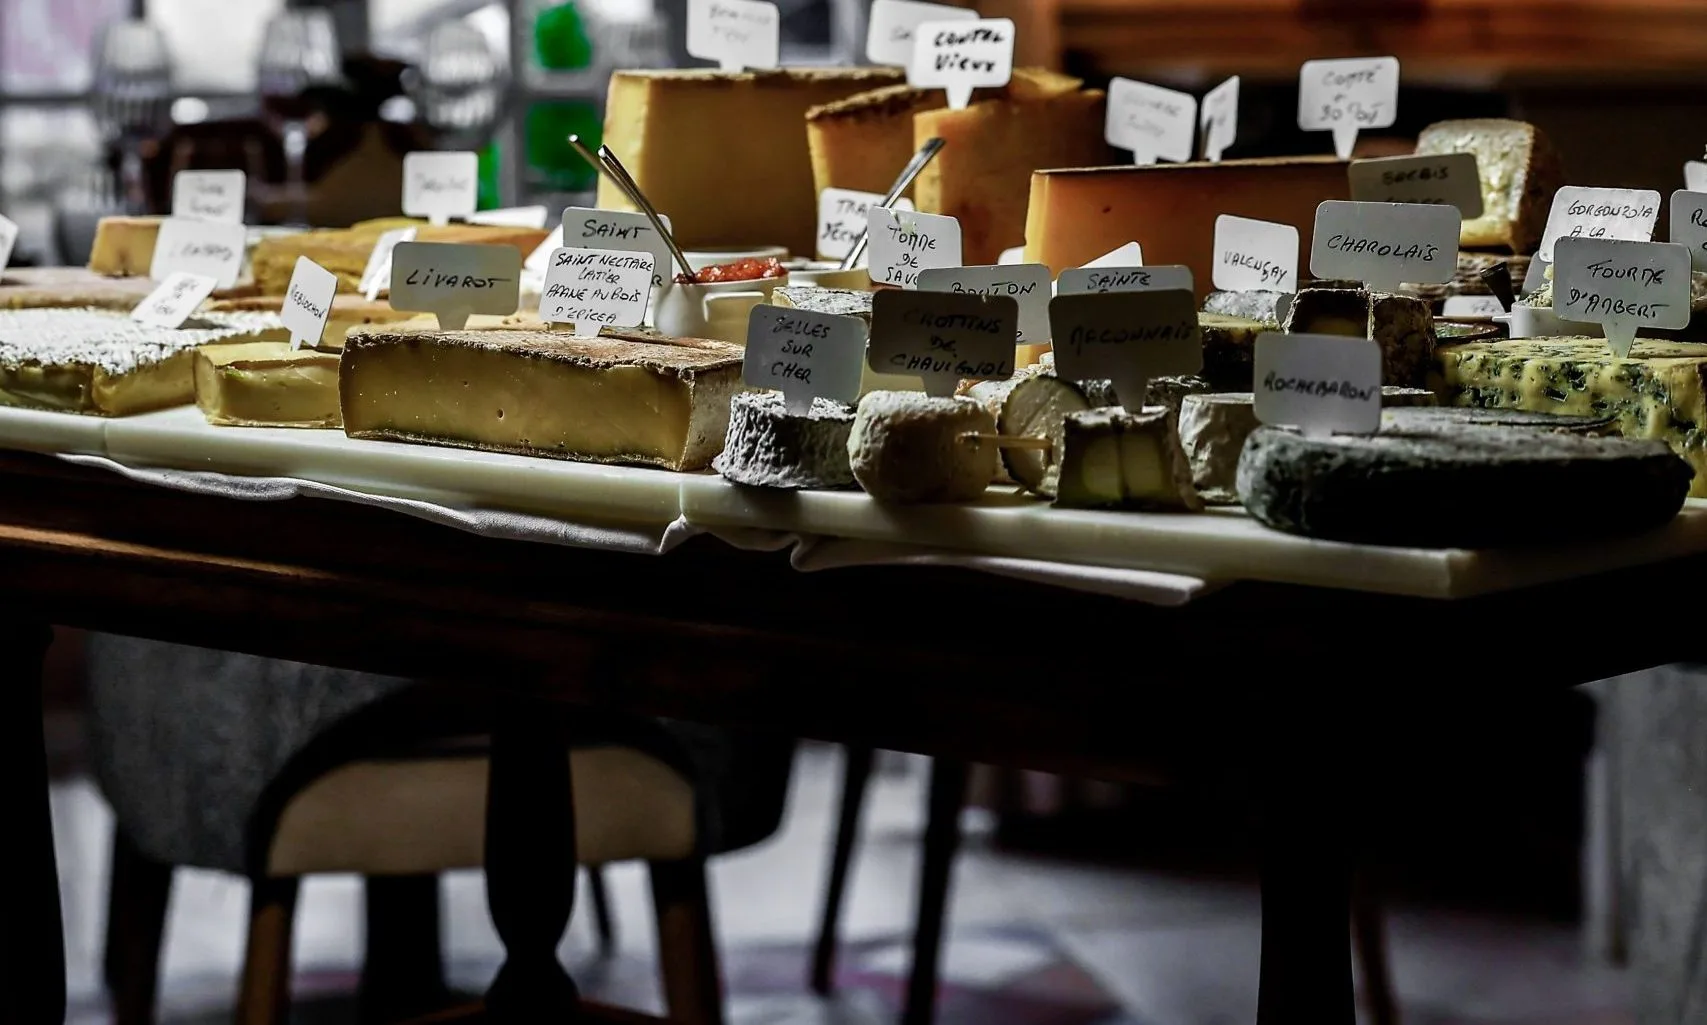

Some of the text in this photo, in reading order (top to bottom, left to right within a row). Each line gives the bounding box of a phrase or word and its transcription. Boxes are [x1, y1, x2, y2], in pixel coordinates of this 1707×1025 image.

[1567, 199, 1654, 219] GORGONZOLA
[582, 219, 651, 239] SAINT
[887, 225, 937, 251] TOMME
[1327, 233, 1440, 262] CHAROLAIS
[555, 252, 653, 272] SAINT NECTAIRE
[896, 253, 919, 269] DE
[405, 267, 512, 290] LIVAROT
[1087, 271, 1152, 290] SAINTE
[1587, 259, 1666, 288] FOURME
[289, 283, 328, 321] REBLOCHON
[591, 288, 610, 301] AU
[611, 286, 641, 303] BOIS
[1566, 287, 1670, 319] D'AMBERT
[902, 306, 1003, 335] CROTTINS
[781, 339, 814, 358] SUR
[929, 335, 956, 353] DE
[771, 361, 812, 385] CHER
[889, 352, 1009, 379] CHAVIGNOL
[1263, 369, 1379, 402] ROCHEBARON
